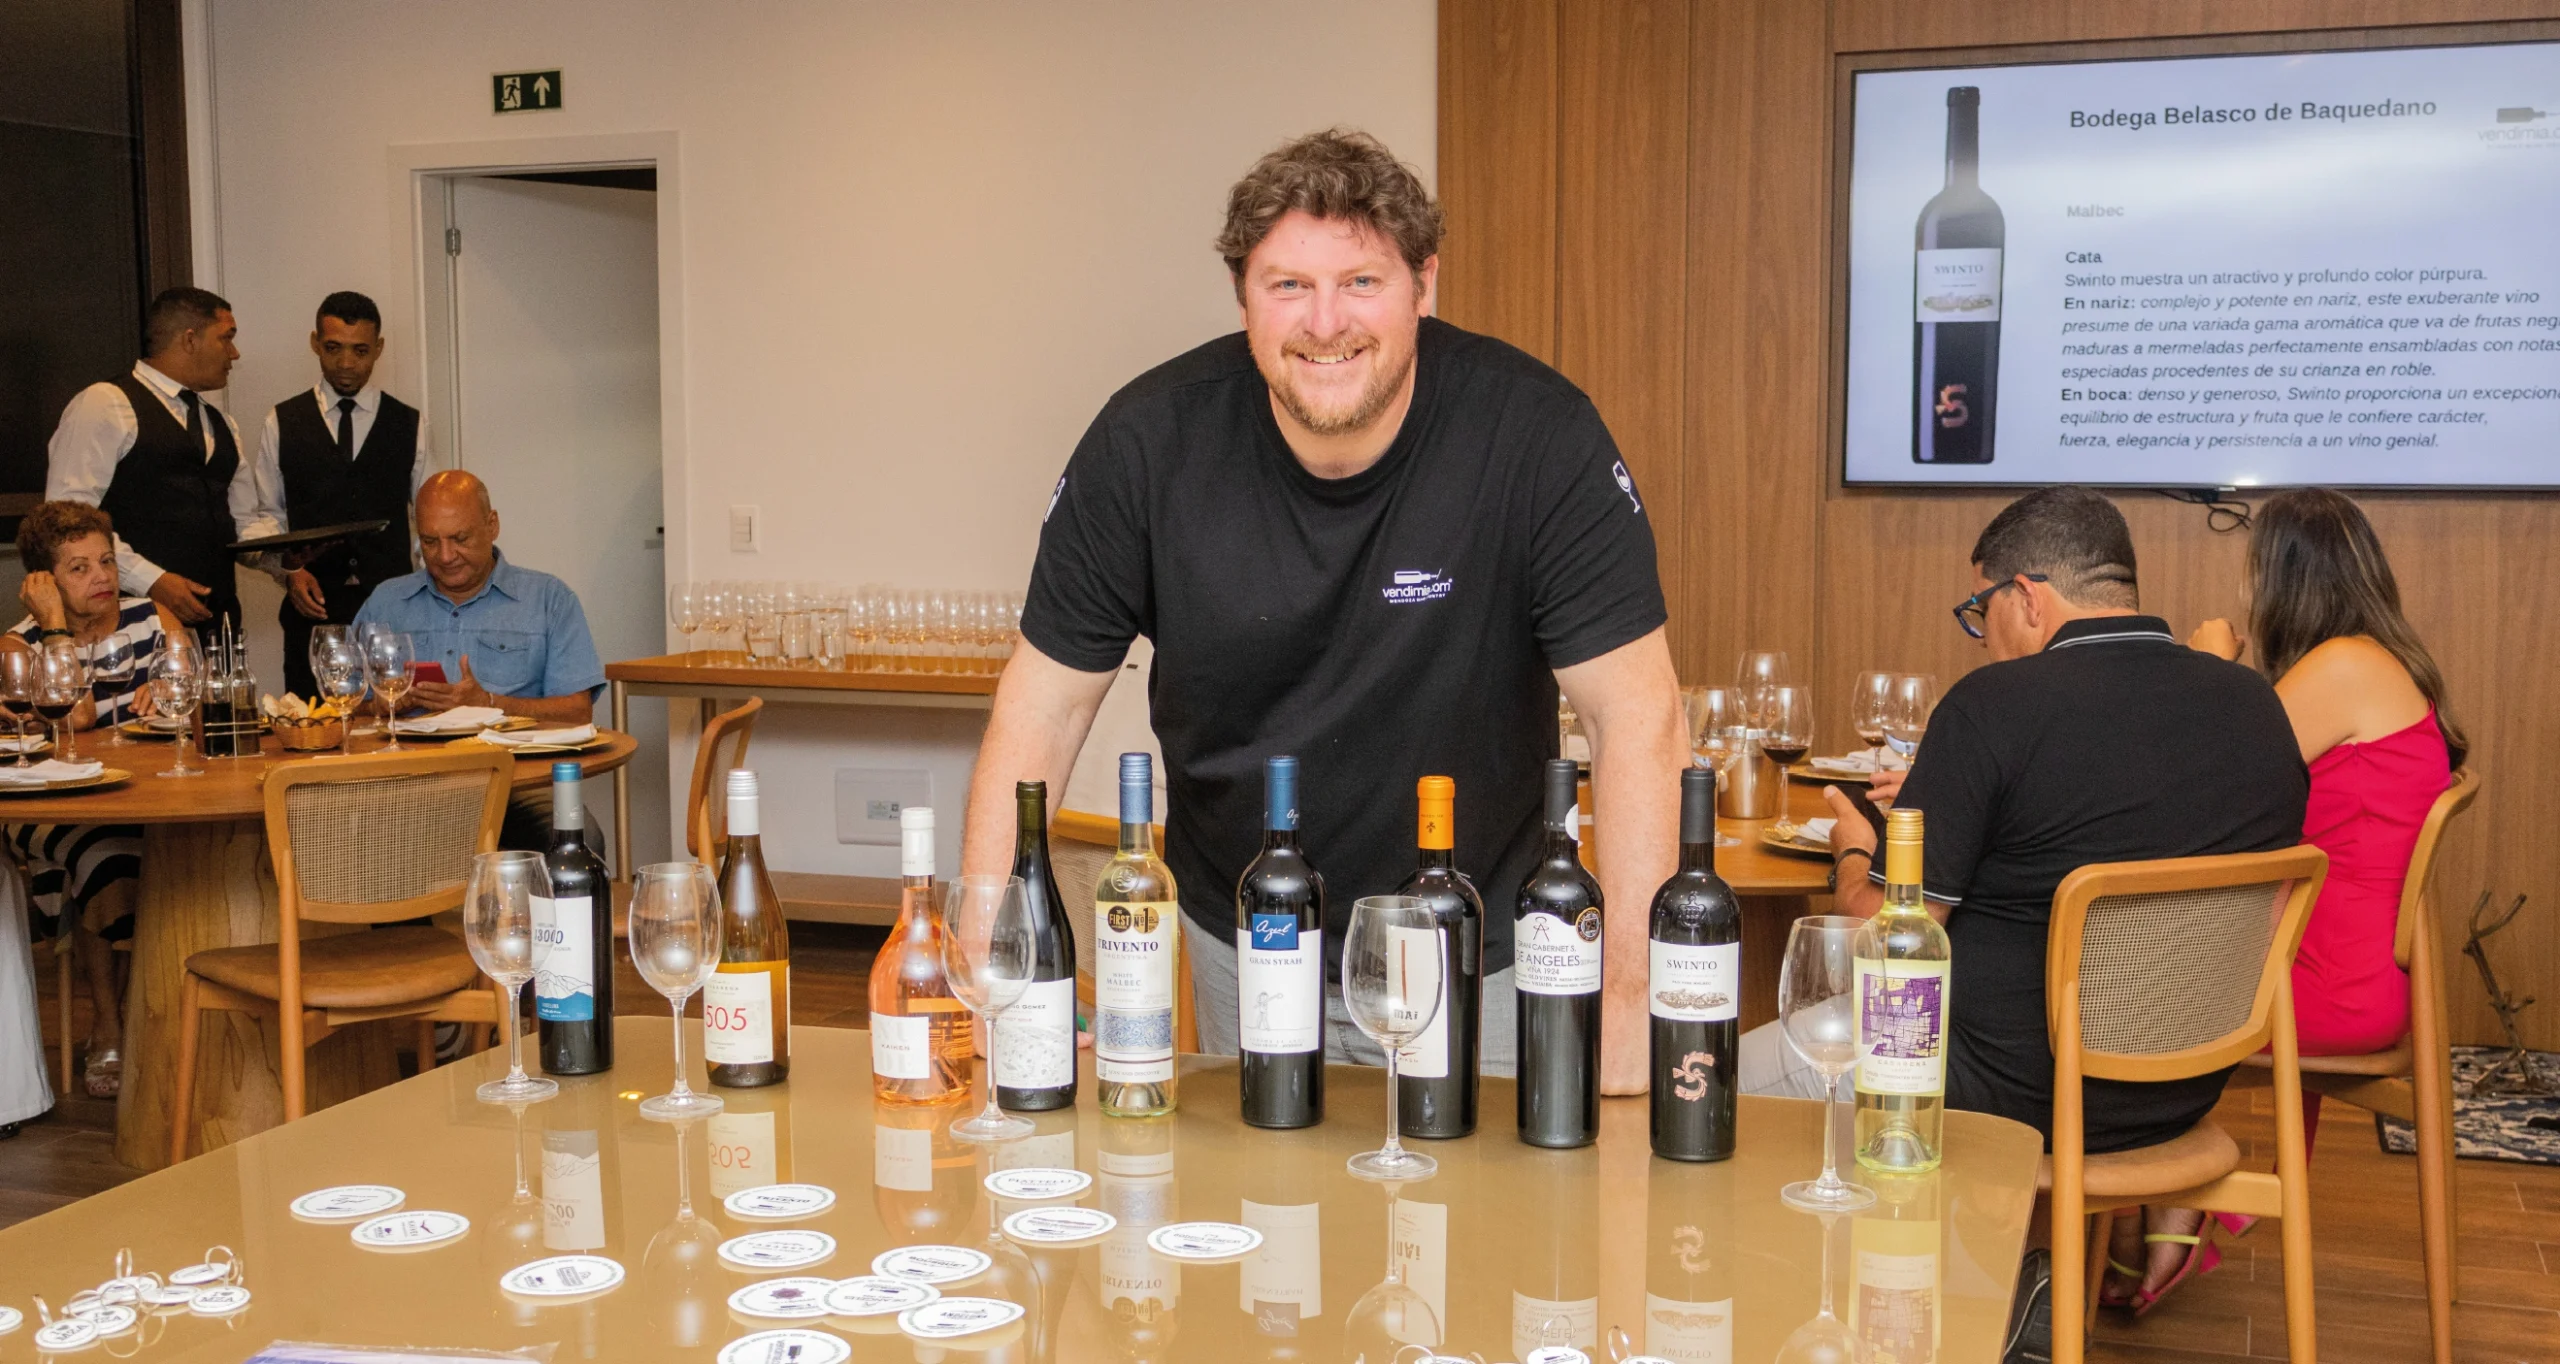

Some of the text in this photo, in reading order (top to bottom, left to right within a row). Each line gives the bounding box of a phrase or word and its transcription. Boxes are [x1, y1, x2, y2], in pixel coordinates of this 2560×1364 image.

[2069, 98, 2438, 130] Bodega Belasco de Baquedano
[2066, 204, 2125, 218] Malbec
[2065, 251, 2103, 264] Cata
[1934, 264, 1984, 275] SWINTO
[2065, 266, 2488, 288] Swinto muestra un atractivo y profundo color púrpura.
[2064, 289, 2541, 311] En nariz: complejo y potente en nariz, este exuberante vino
[2062, 320, 2130, 335] presume
[2134, 318, 2154, 332] de
[2158, 320, 2188, 332] una
[2192, 317, 2250, 332] variada
[2254, 319, 2300, 334] gama
[2304, 314, 2384, 330] aromática
[2388, 317, 2420, 332] que
[2424, 317, 2445, 329] va
[2449, 314, 2470, 328] de
[2474, 313, 2522, 328] frutas
[2062, 338, 2560, 356] maduras a mermeladas perfectamente ensambladas con notas
[2061, 362, 2437, 381] especiadas procedentes de su crianza en roble.
[2061, 388, 2083, 401] En
[2088, 387, 2133, 401] boca:
[2138, 387, 2186, 401] denso
[2189, 390, 2201, 404] y
[2203, 389, 2281, 404] generoso,
[2286, 386, 2341, 401] Swinto
[2344, 385, 2443, 404] proporciona
[2447, 387, 2468, 400] un
[2059, 409, 2489, 427] equilibrio de estructura y fruta que le confiere carácter,
[2059, 432, 2440, 451] fuerza, elegancia y persistencia a un vino genial.
[1109, 914, 1131, 927] FIRST
[1256, 919, 1293, 943] Azul
[1097, 938, 1159, 953] TRIVENTO
[1532, 943, 1569, 953] CABERNET
[1249, 957, 1303, 967] GRAN SYRAH
[1525, 953, 1581, 967] ANGELES
[1666, 959, 1718, 971] SWINTO
[1543, 967, 1560, 976] 1924
[1106, 978, 1142, 988] MALBEC
[705, 1004, 748, 1032] 505
[881, 1043, 911, 1052] KAIKEN
[756, 1195, 811, 1204] TRIVENTO
